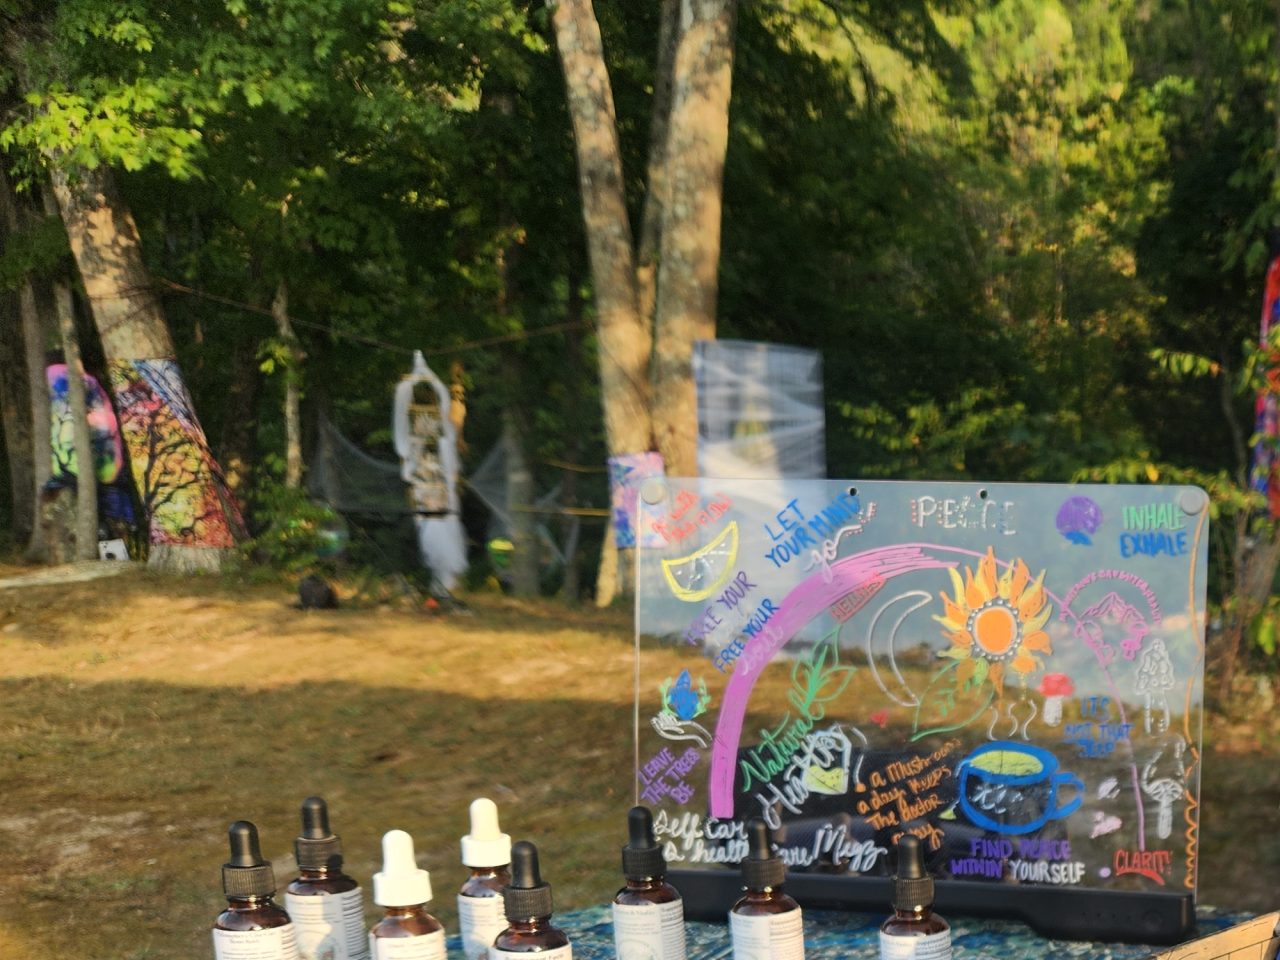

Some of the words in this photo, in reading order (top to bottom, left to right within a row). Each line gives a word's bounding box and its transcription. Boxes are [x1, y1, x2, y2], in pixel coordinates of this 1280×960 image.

[764, 497, 806, 542] LET
[1121, 502, 1187, 531] INHALE
[765, 527, 817, 568] YOUR
[1119, 531, 1188, 559] EXHALE
[716, 570, 758, 611] YOUR
[713, 637, 746, 673] FREE
[742, 597, 781, 639] YOUR
[638, 746, 677, 785] LEAVE
[641, 776, 672, 805] THE
[670, 780, 696, 806] BE
[704, 816, 750, 841] Car
[969, 837, 1015, 859] FIND
[1008, 859, 1087, 886] YOURSELF
